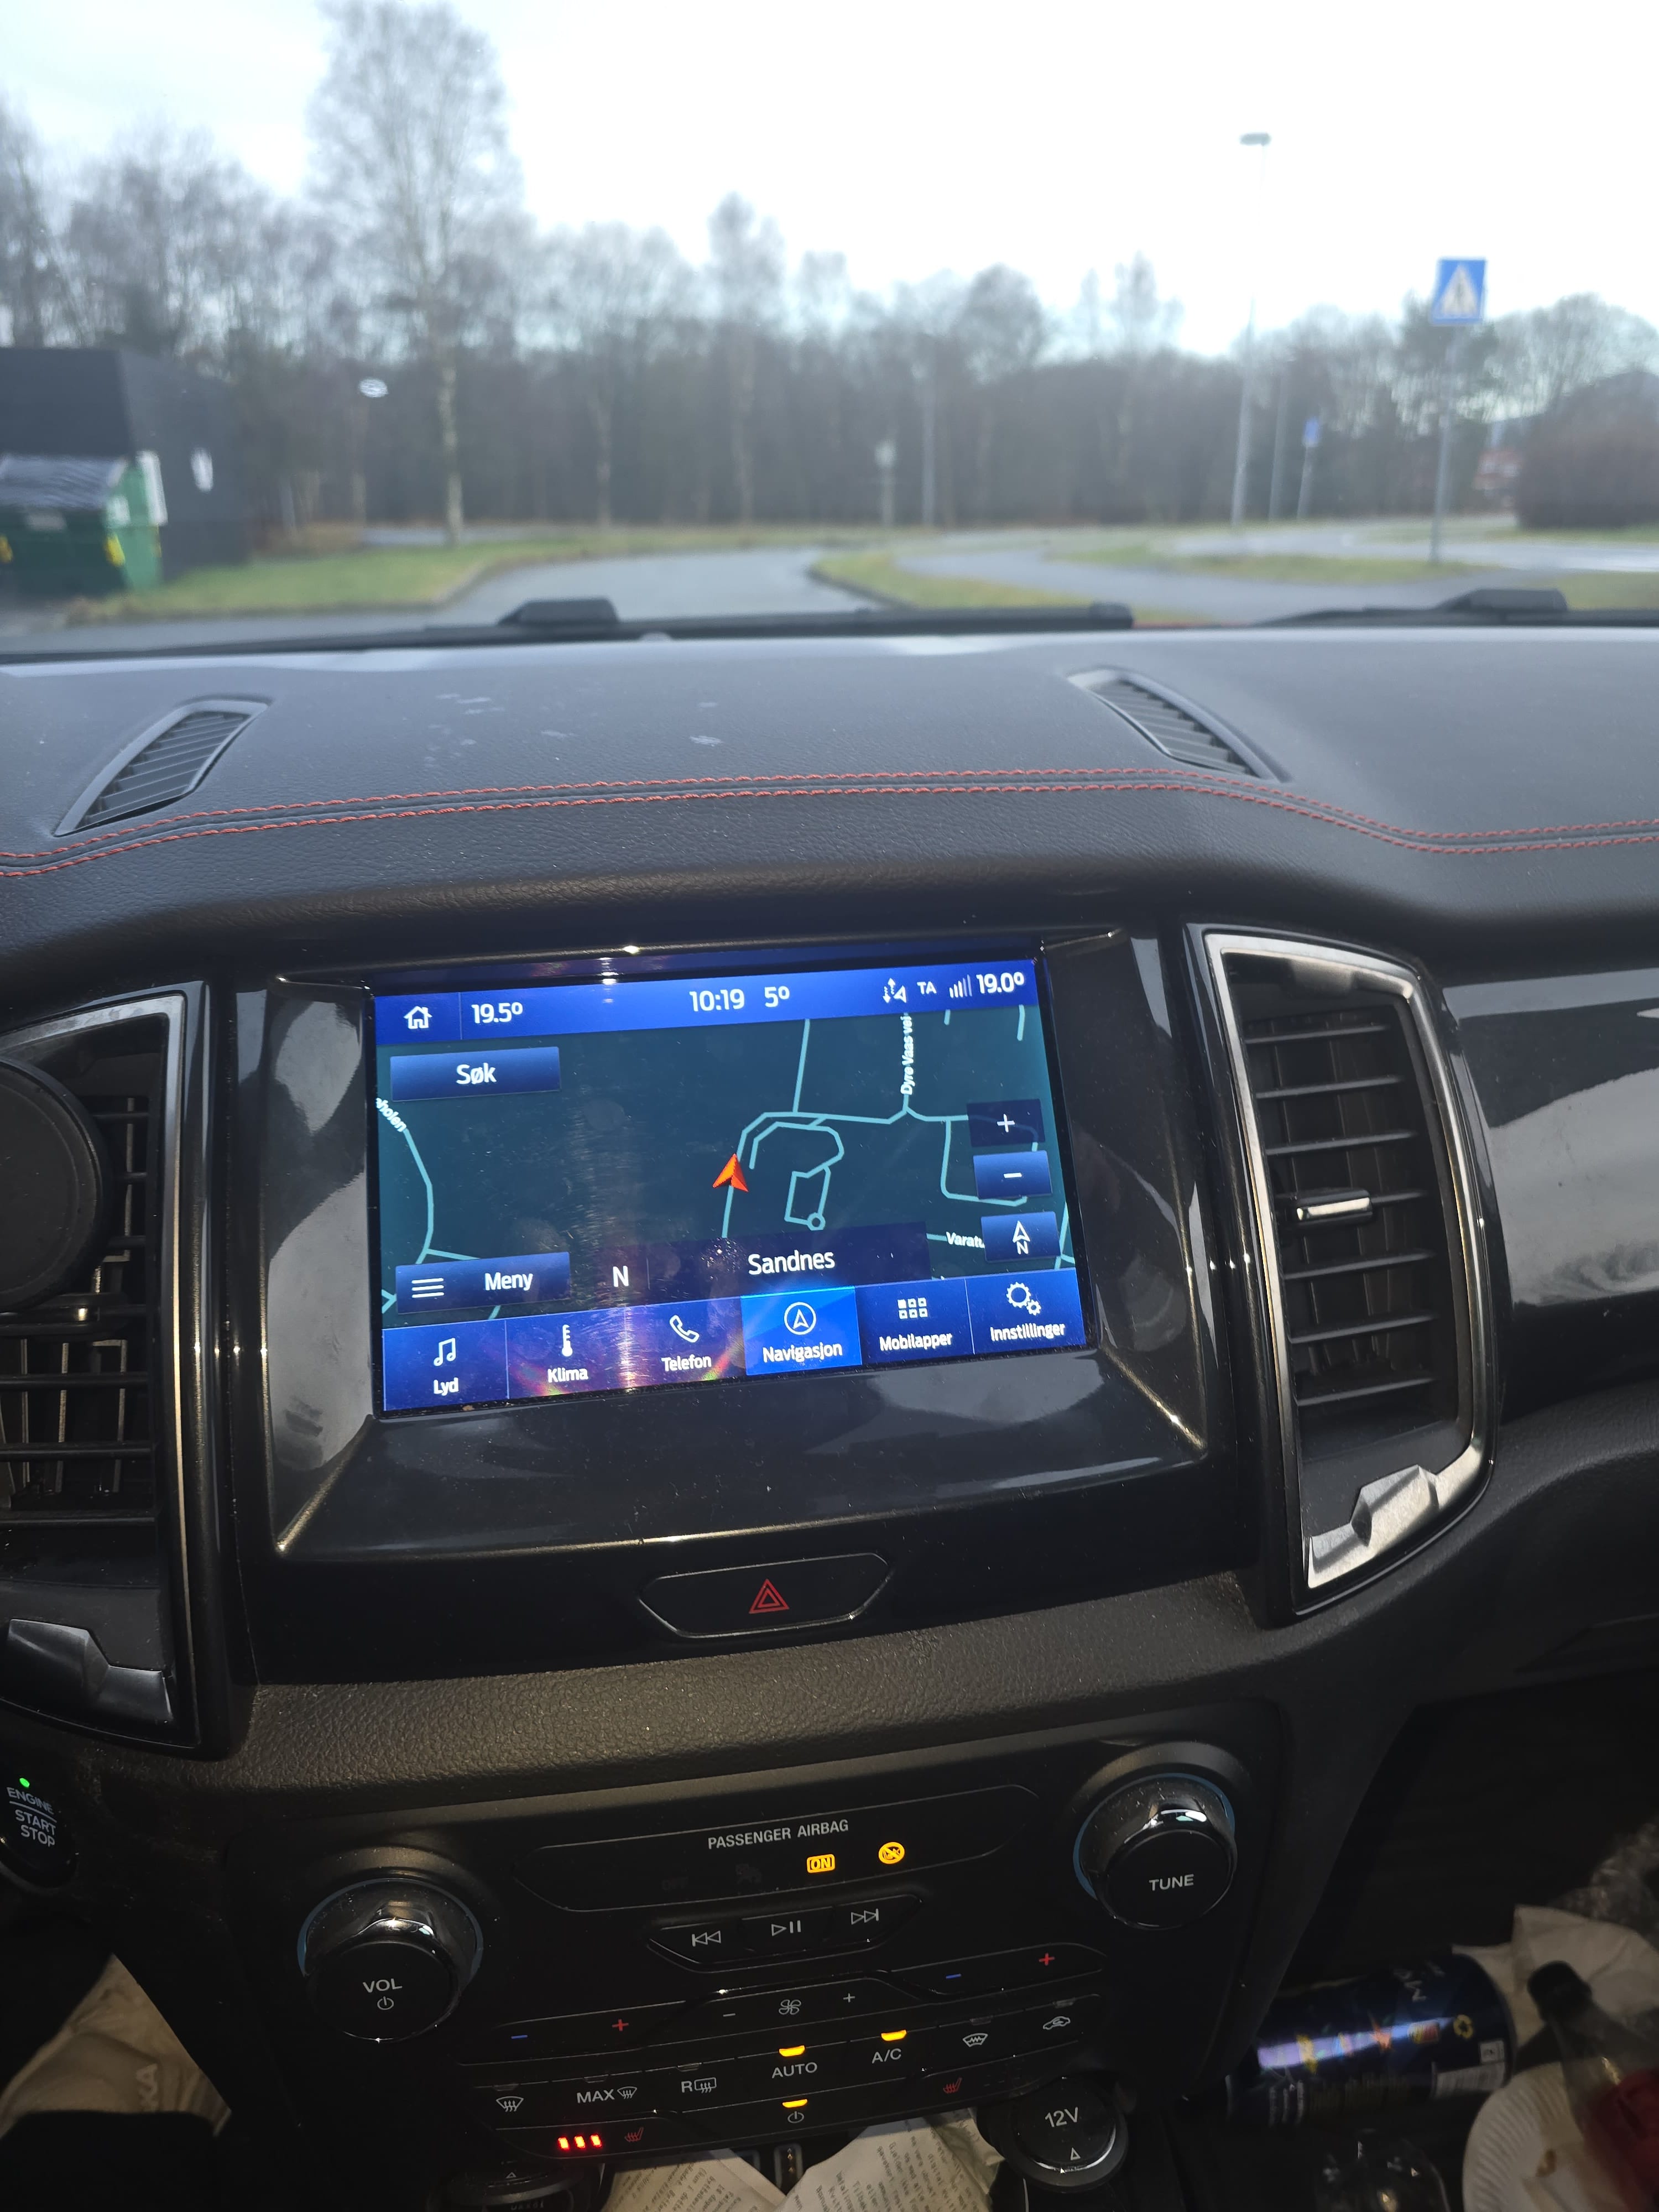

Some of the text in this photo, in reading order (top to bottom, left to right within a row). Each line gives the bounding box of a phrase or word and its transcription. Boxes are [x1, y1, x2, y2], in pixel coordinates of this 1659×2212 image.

[917, 981, 937, 995] TA
[690, 989, 744, 1013] 10:19
[900, 1016, 915, 1095] Dyre Vaas vei
[456, 1063, 497, 1085] Søk
[748, 1250, 835, 1275] Sandnes
[485, 1272, 533, 1293] Meny
[613, 1265, 629, 1287] N
[990, 1323, 1065, 1341] Innstillinger
[879, 1333, 952, 1353] Mobilapper
[661, 1354, 712, 1373] Telefon
[763, 1343, 843, 1364] Navigasjon
[547, 1366, 588, 1384] Klima
[434, 1378, 459, 1396] Lyd
[7, 1787, 54, 1815] ENGINE
[15, 1809, 56, 1835] START
[20, 1825, 55, 1846] STOP
[708, 1819, 849, 1850] PASSENGER AIRBAG
[810, 1858, 831, 1870] ON
[1149, 1874, 1194, 1891] TUNE
[363, 1978, 403, 1993] VOL
[872, 2048, 902, 2063] A/C
[772, 2062, 818, 2079] AUTO
[577, 2088, 615, 2104] MAX
[681, 2080, 692, 2093] R
[1045, 2106, 1078, 2127] 12V
